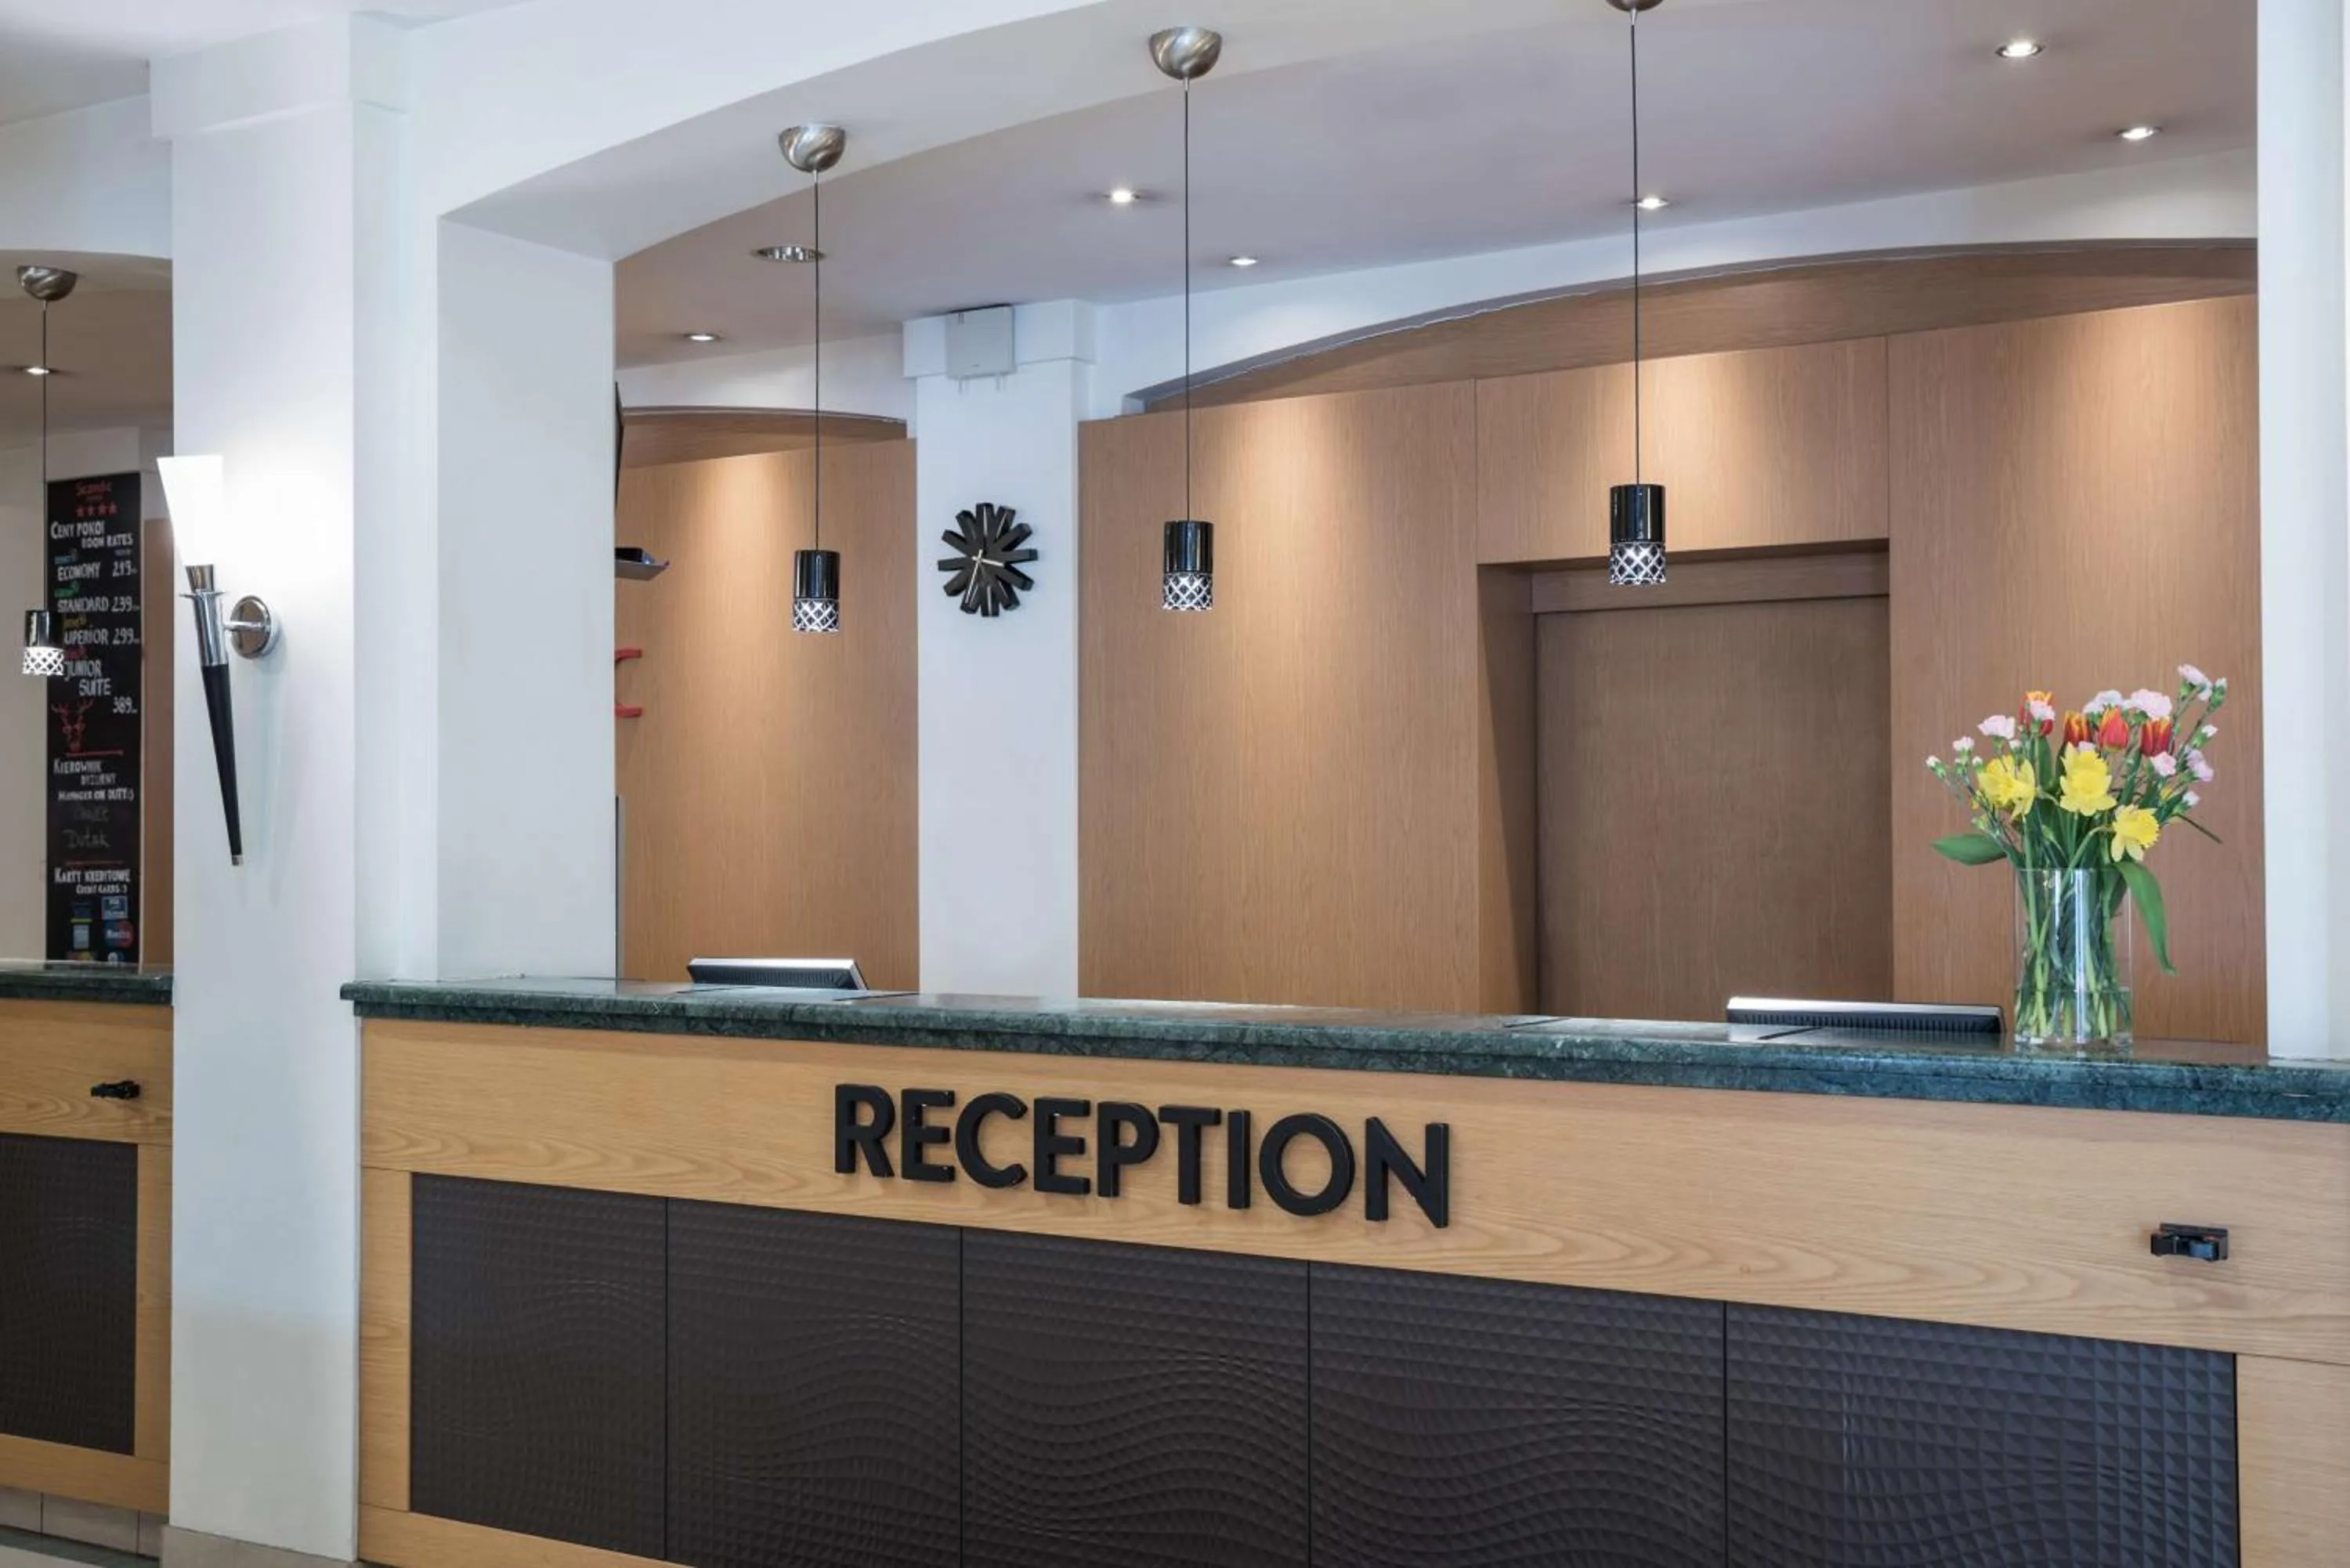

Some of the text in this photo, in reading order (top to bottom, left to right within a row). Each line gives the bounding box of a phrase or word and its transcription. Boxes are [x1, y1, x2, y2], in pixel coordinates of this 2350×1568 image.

[57, 562, 101, 581] ECONOMY
[57, 596, 109, 613] STANDARD
[64, 627, 109, 645] UPERIOR
[79, 677, 112, 696] SUITE
[833, 1083, 1449, 1229] RECEPTION
